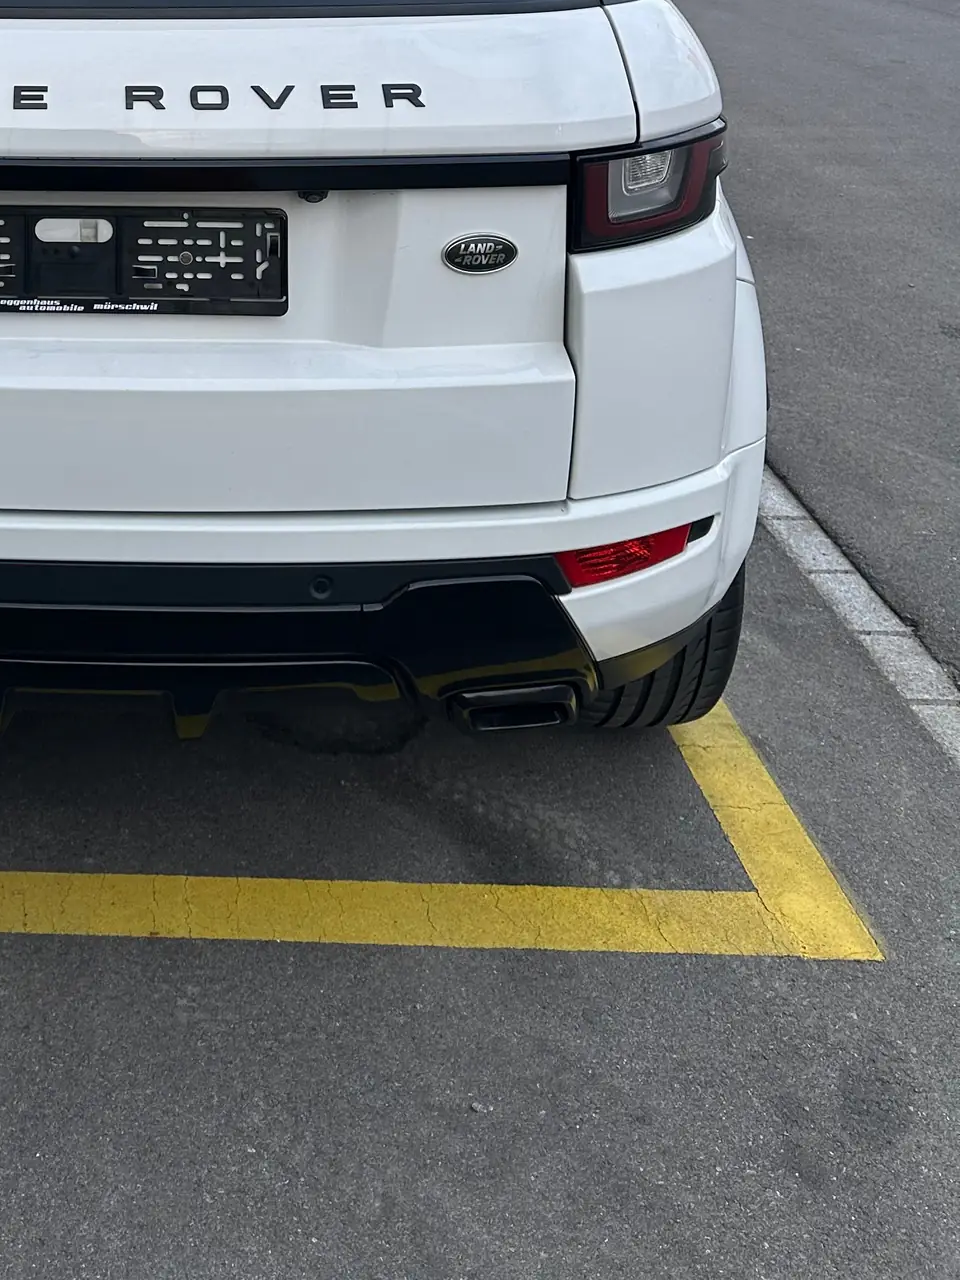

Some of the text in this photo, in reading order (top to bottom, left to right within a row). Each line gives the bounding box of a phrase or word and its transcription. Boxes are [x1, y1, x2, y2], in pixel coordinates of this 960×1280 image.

[124, 82, 426, 110] ROVER
[458, 242, 495, 254] LAND
[462, 253, 505, 265] ROVER
